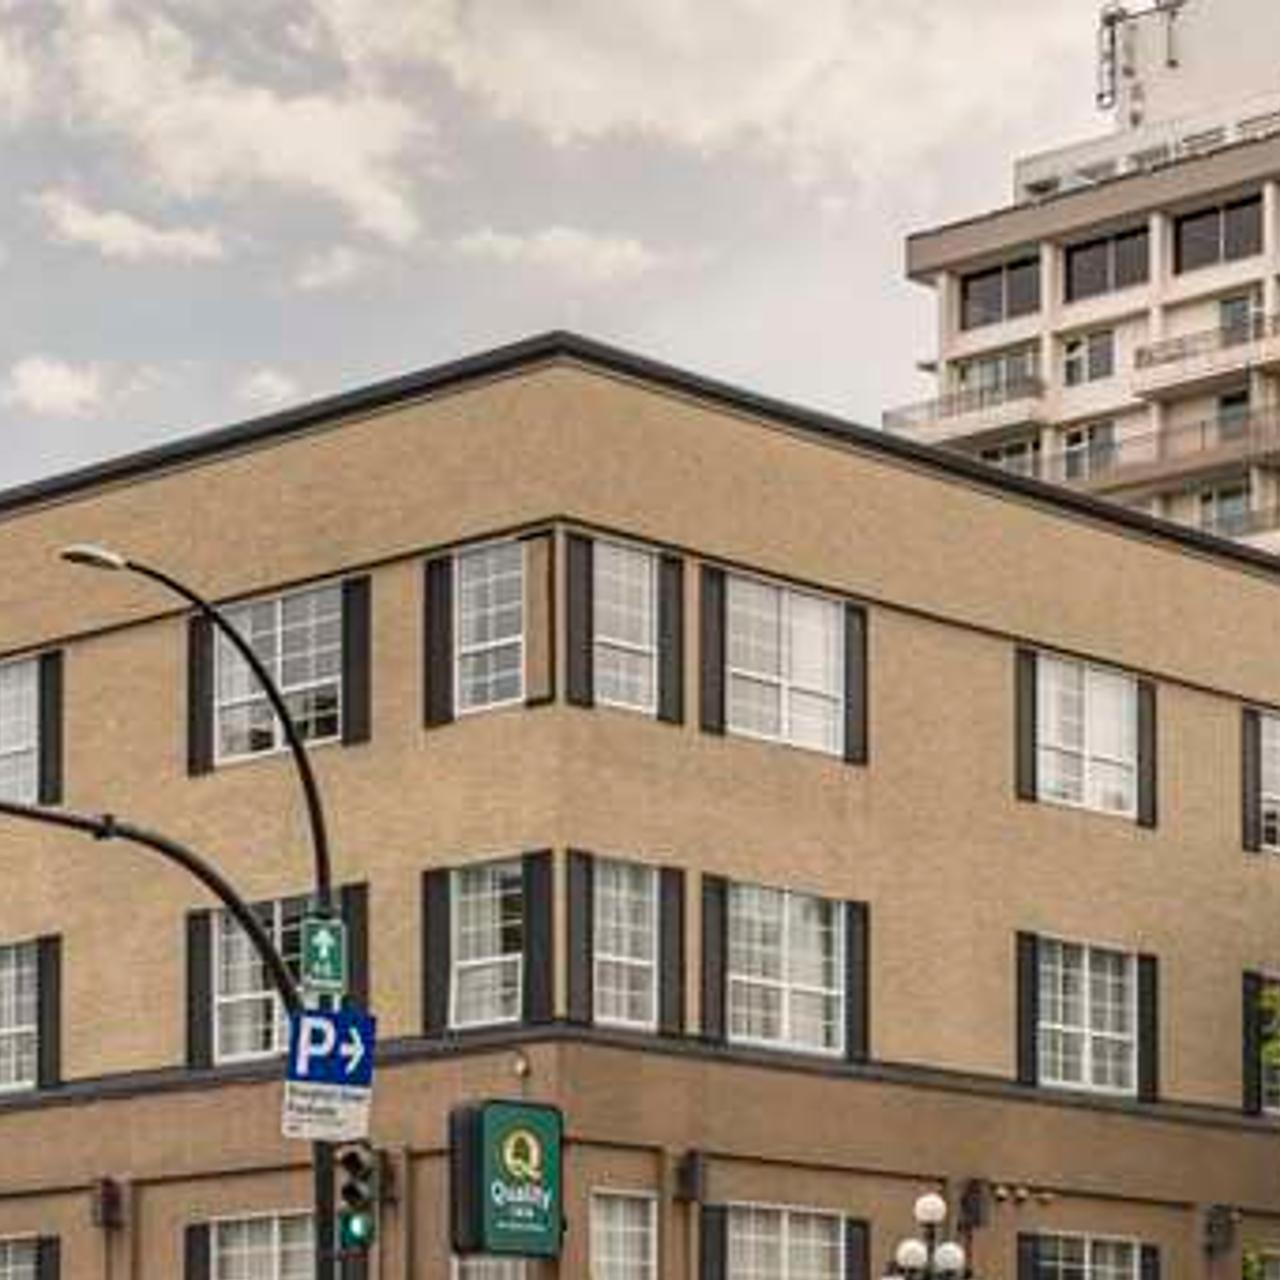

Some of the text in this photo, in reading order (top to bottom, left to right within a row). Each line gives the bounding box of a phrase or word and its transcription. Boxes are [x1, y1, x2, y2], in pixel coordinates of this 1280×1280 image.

[296, 1016, 336, 1076] P
[503, 1129, 542, 1181] Q
[491, 1179, 553, 1211] Quality
